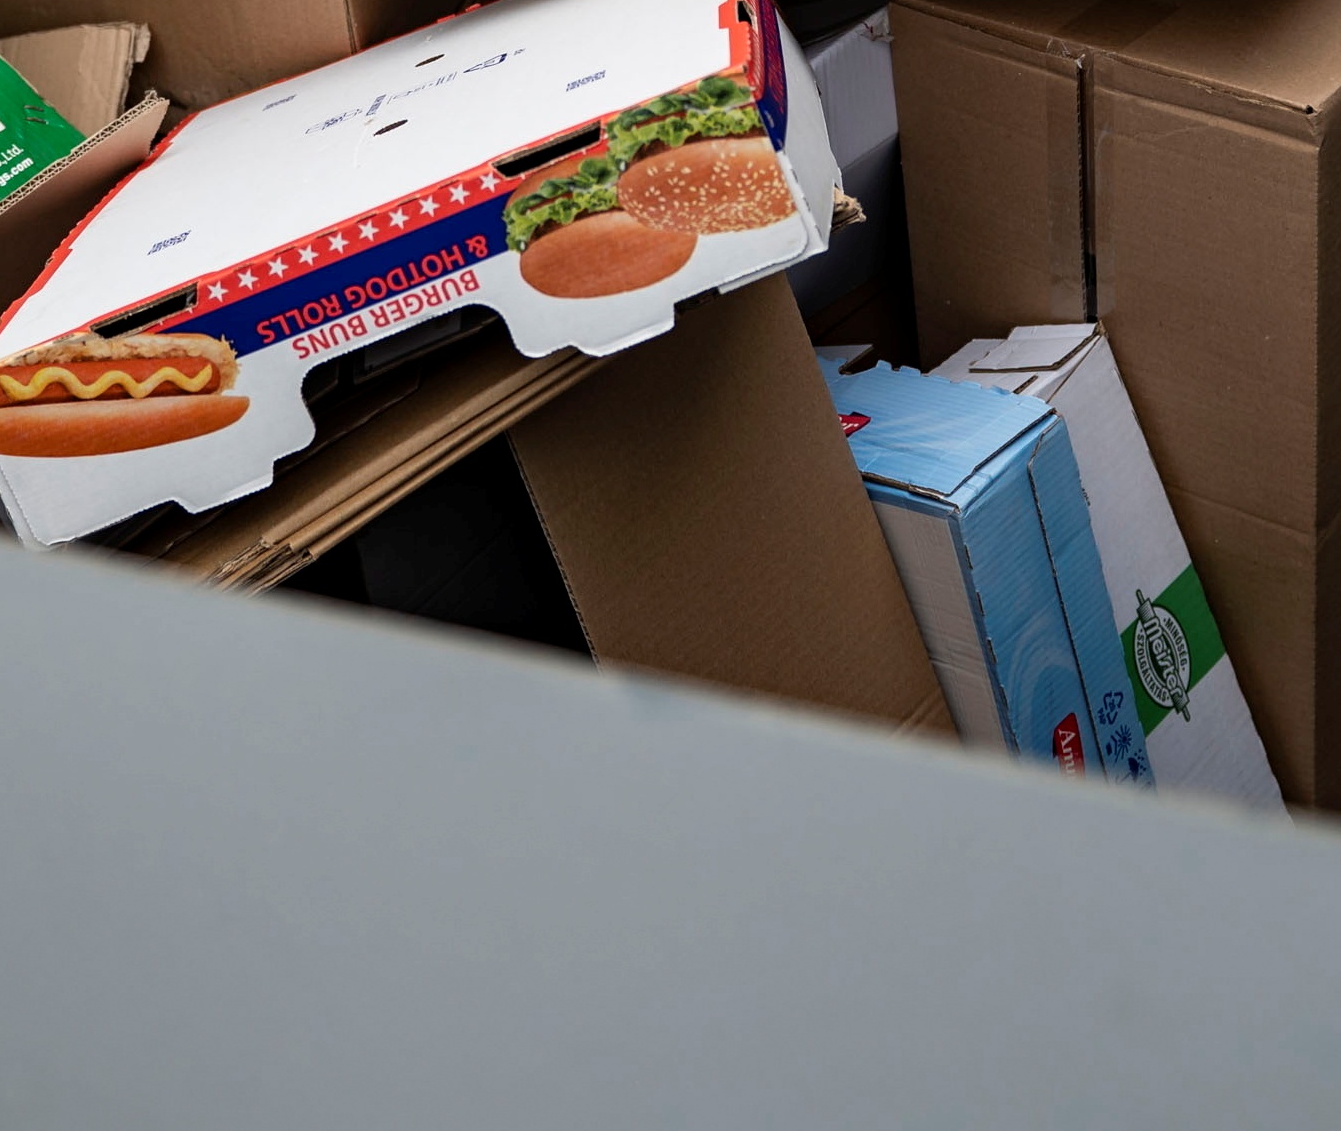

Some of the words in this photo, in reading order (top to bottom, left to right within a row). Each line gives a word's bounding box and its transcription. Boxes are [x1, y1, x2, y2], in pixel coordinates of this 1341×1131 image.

[465, 235, 489, 260] &
[344, 244, 465, 309] HOTDOG
[368, 269, 480, 329] BURGER
[256, 294, 343, 344] ROLLS
[292, 315, 368, 360] BUNS
